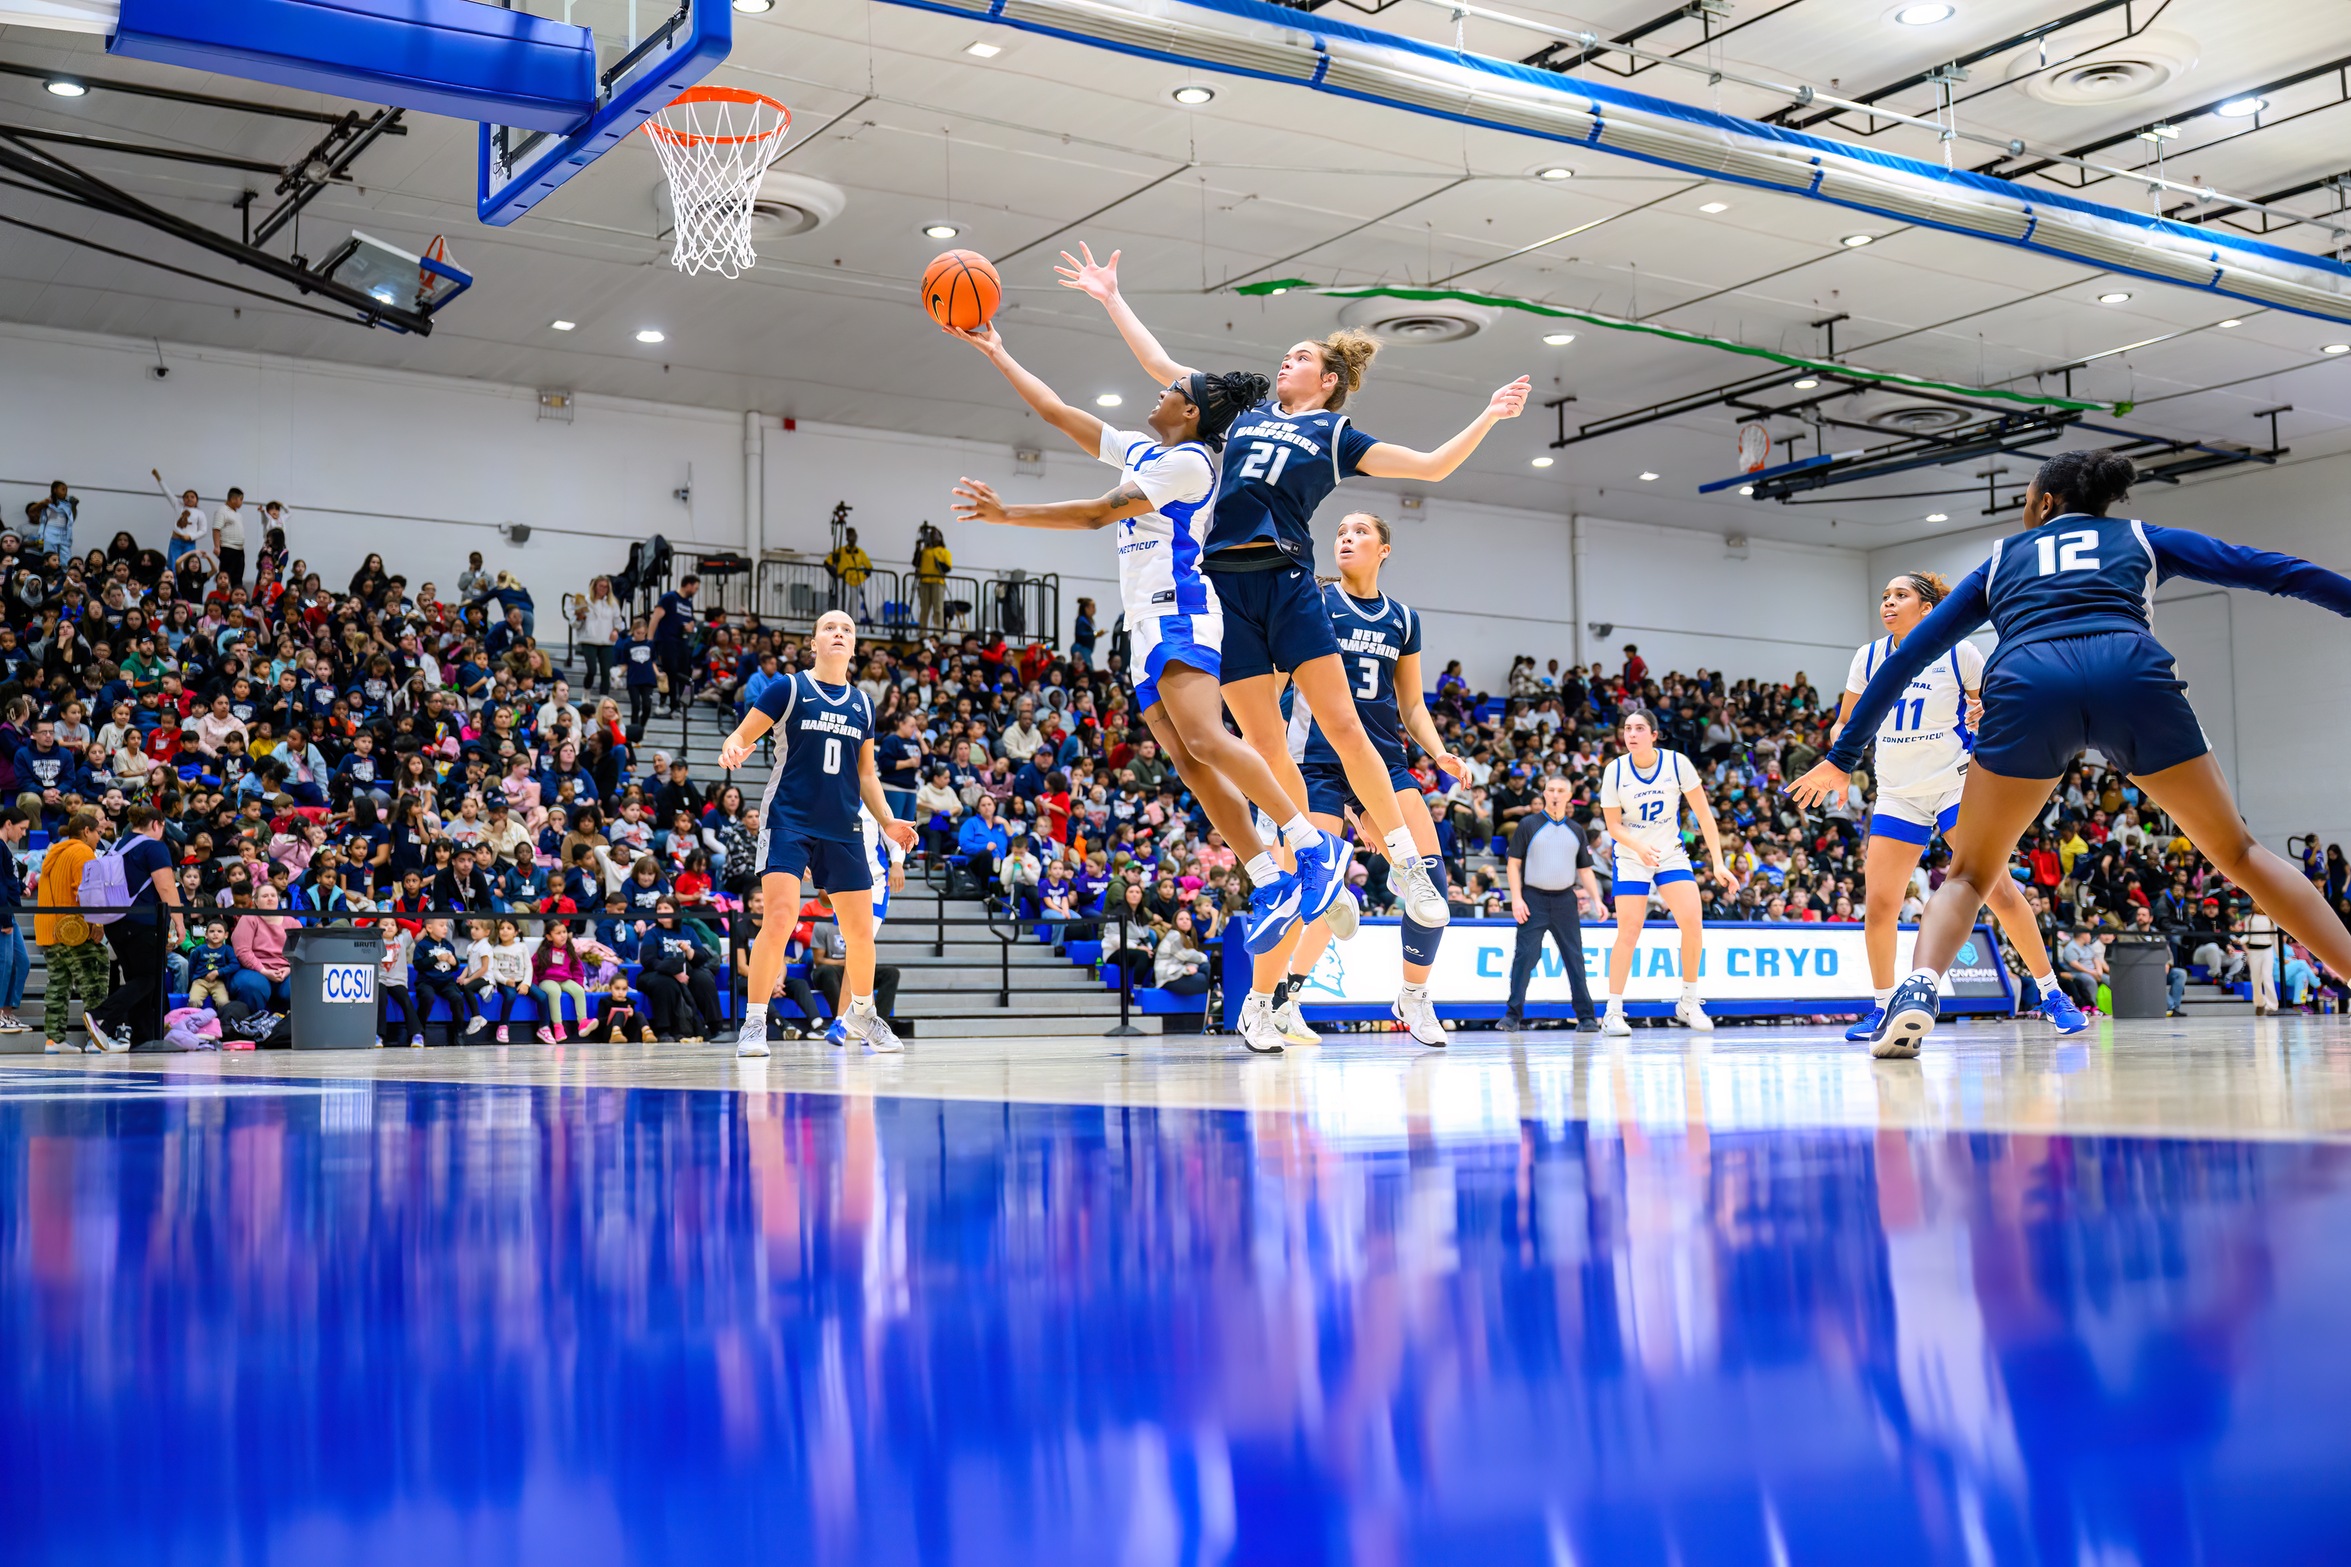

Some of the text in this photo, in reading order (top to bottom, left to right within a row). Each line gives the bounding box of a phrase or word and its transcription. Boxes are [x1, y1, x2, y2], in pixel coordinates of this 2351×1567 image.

[1233, 426, 1320, 456] HAMPSHIRE
[1259, 420, 1300, 433] NEW
[1239, 441, 1292, 486] 21
[2034, 529, 2100, 577] 12
[1351, 628, 1386, 644] NEW
[1356, 657, 1380, 700] 3
[820, 710, 848, 725] NEW
[1893, 697, 1926, 732] 11
[822, 737, 842, 775] 0
[1633, 790, 1665, 799] CENTRAL
[1639, 800, 1665, 822] 12
[1727, 947, 1839, 977] CRYO
[327, 968, 372, 999] CCSU
